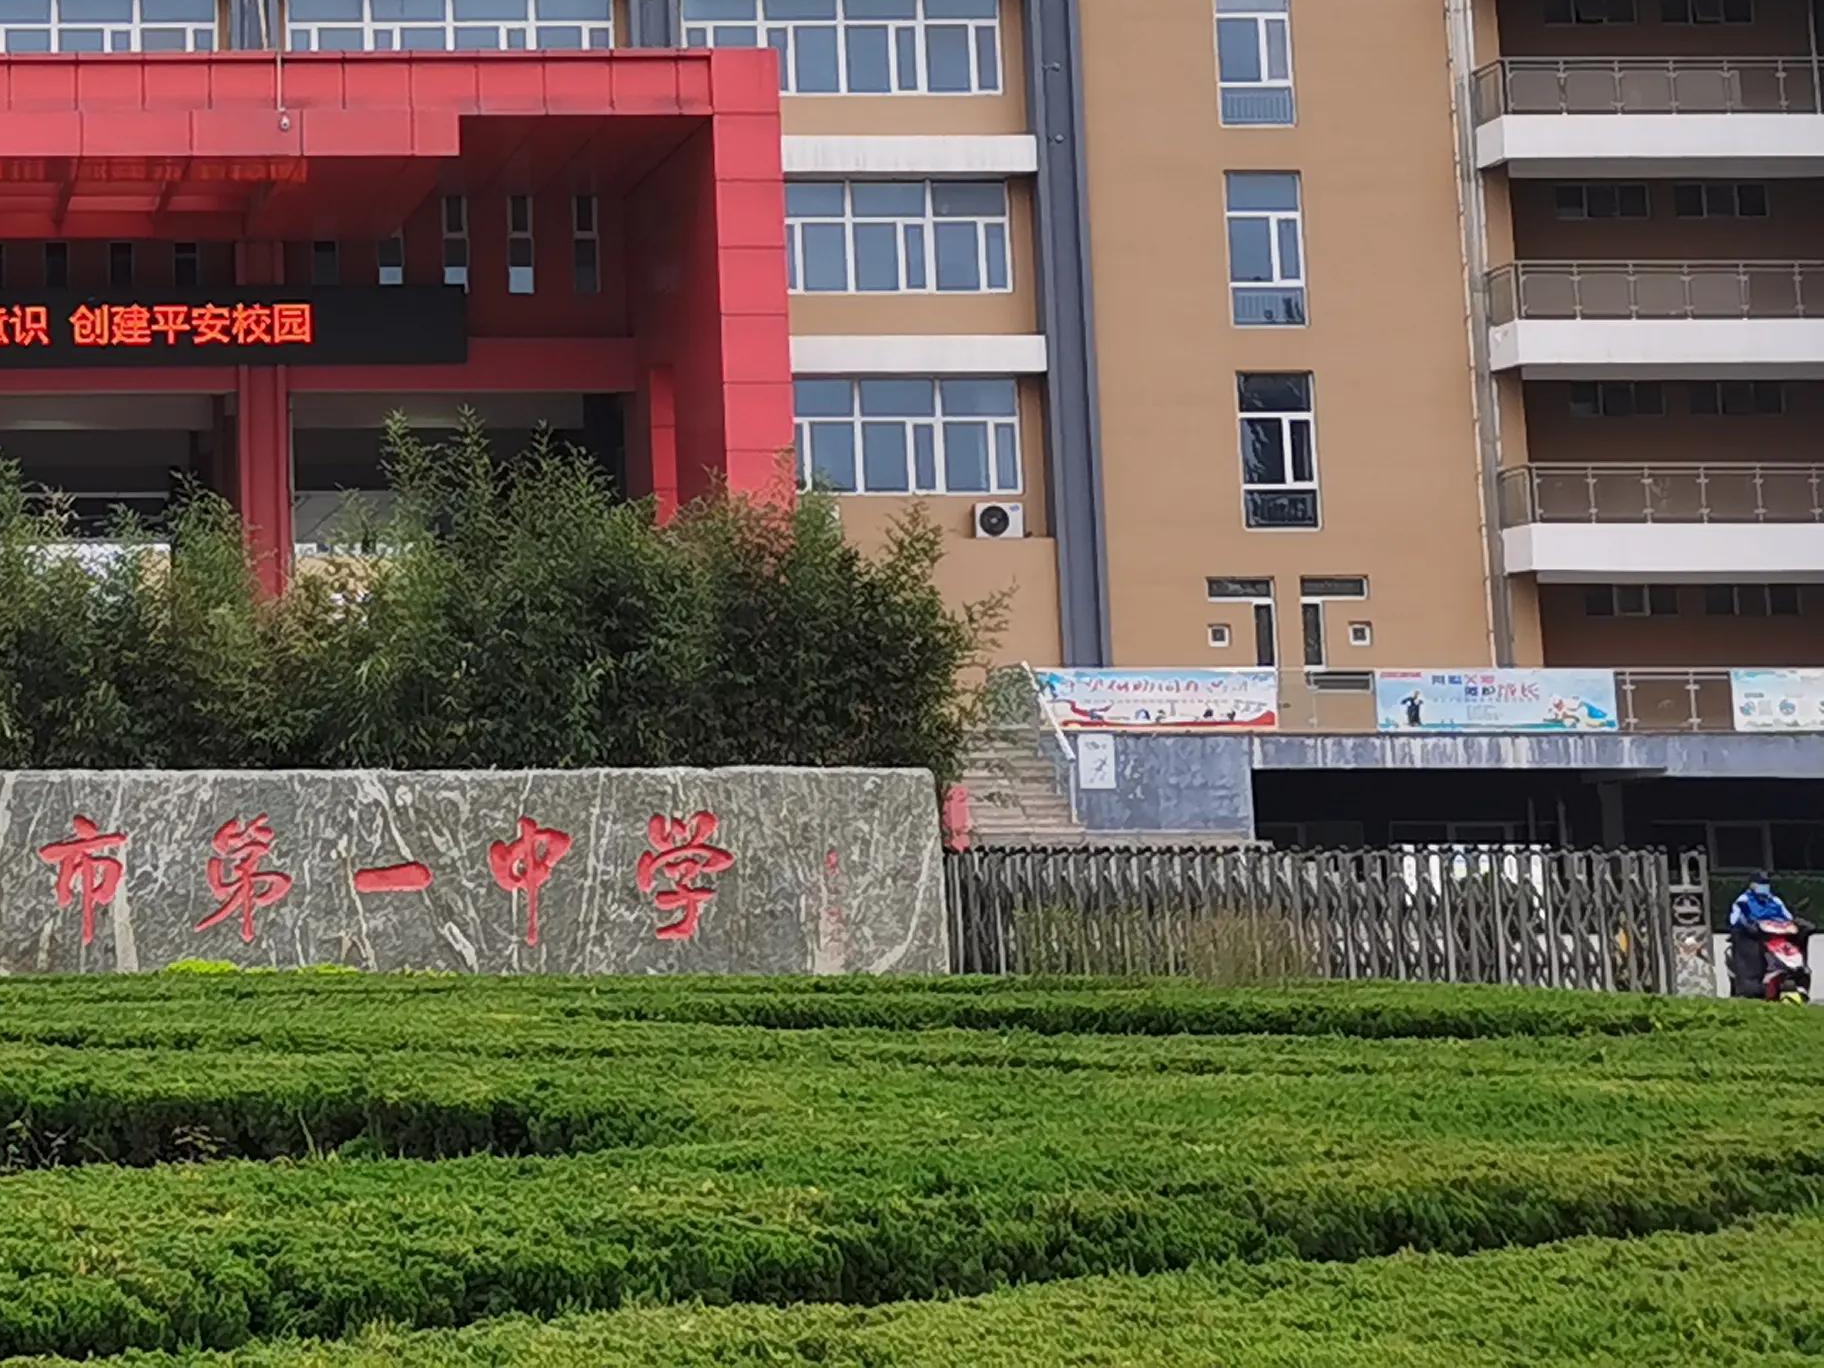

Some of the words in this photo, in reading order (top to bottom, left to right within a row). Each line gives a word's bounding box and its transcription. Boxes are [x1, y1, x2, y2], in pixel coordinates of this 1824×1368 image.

[69, 302, 312, 346] 创建平安校园
